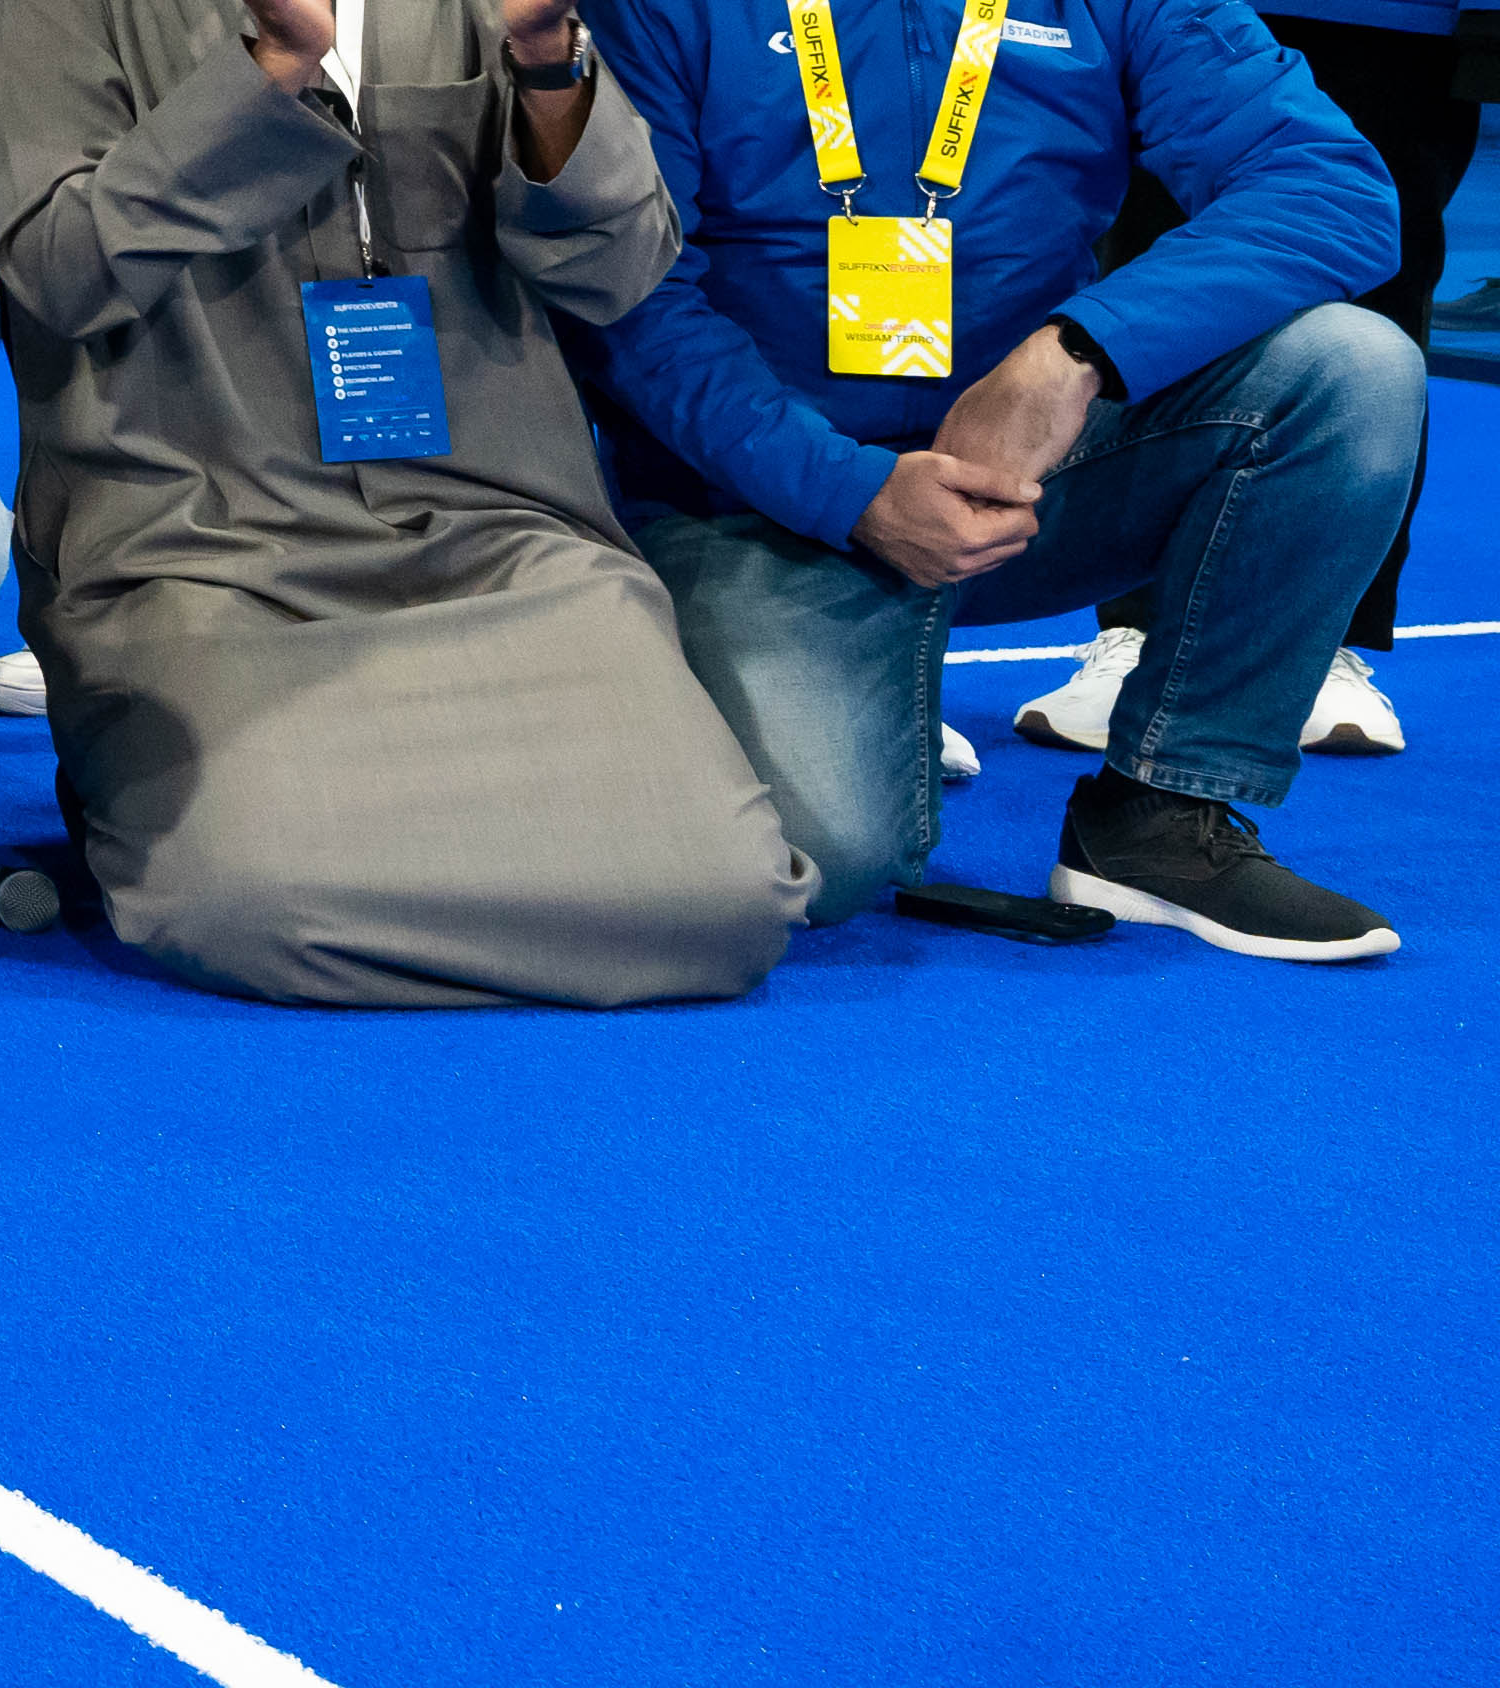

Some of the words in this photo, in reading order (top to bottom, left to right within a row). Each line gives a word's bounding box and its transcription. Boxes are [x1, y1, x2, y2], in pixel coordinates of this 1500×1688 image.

[801, 11, 830, 85] SUFFIX
[1006, 23, 1067, 43] STADIUM
[940, 85, 975, 159] SUFFIX
[845, 332, 892, 343] WISSAM
